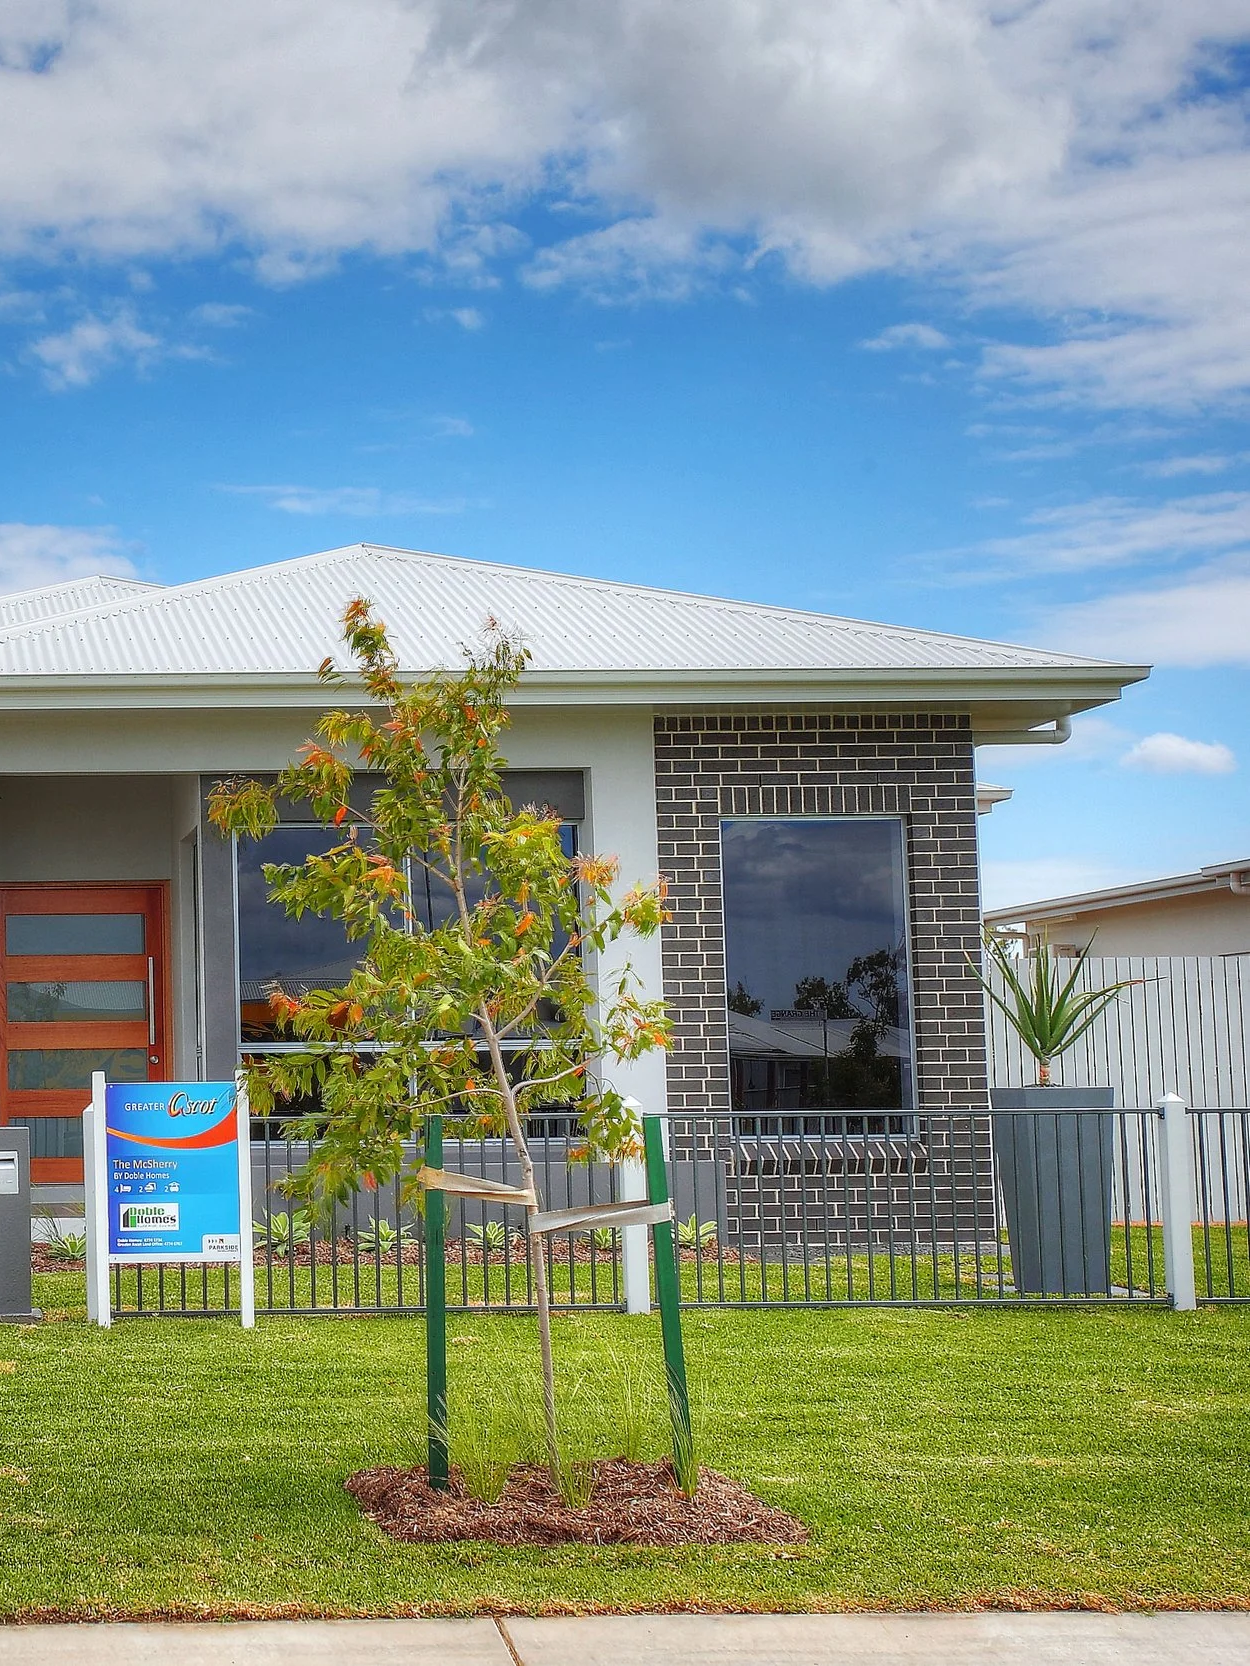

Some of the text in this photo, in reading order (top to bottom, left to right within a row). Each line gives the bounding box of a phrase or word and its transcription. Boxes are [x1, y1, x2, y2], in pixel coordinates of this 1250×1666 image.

[124, 1091, 217, 1117] GREATER Ascot
[113, 1160, 178, 1170] The McSherry
[130, 1207, 165, 1215] Doble
[137, 1216, 177, 1224] Homes
